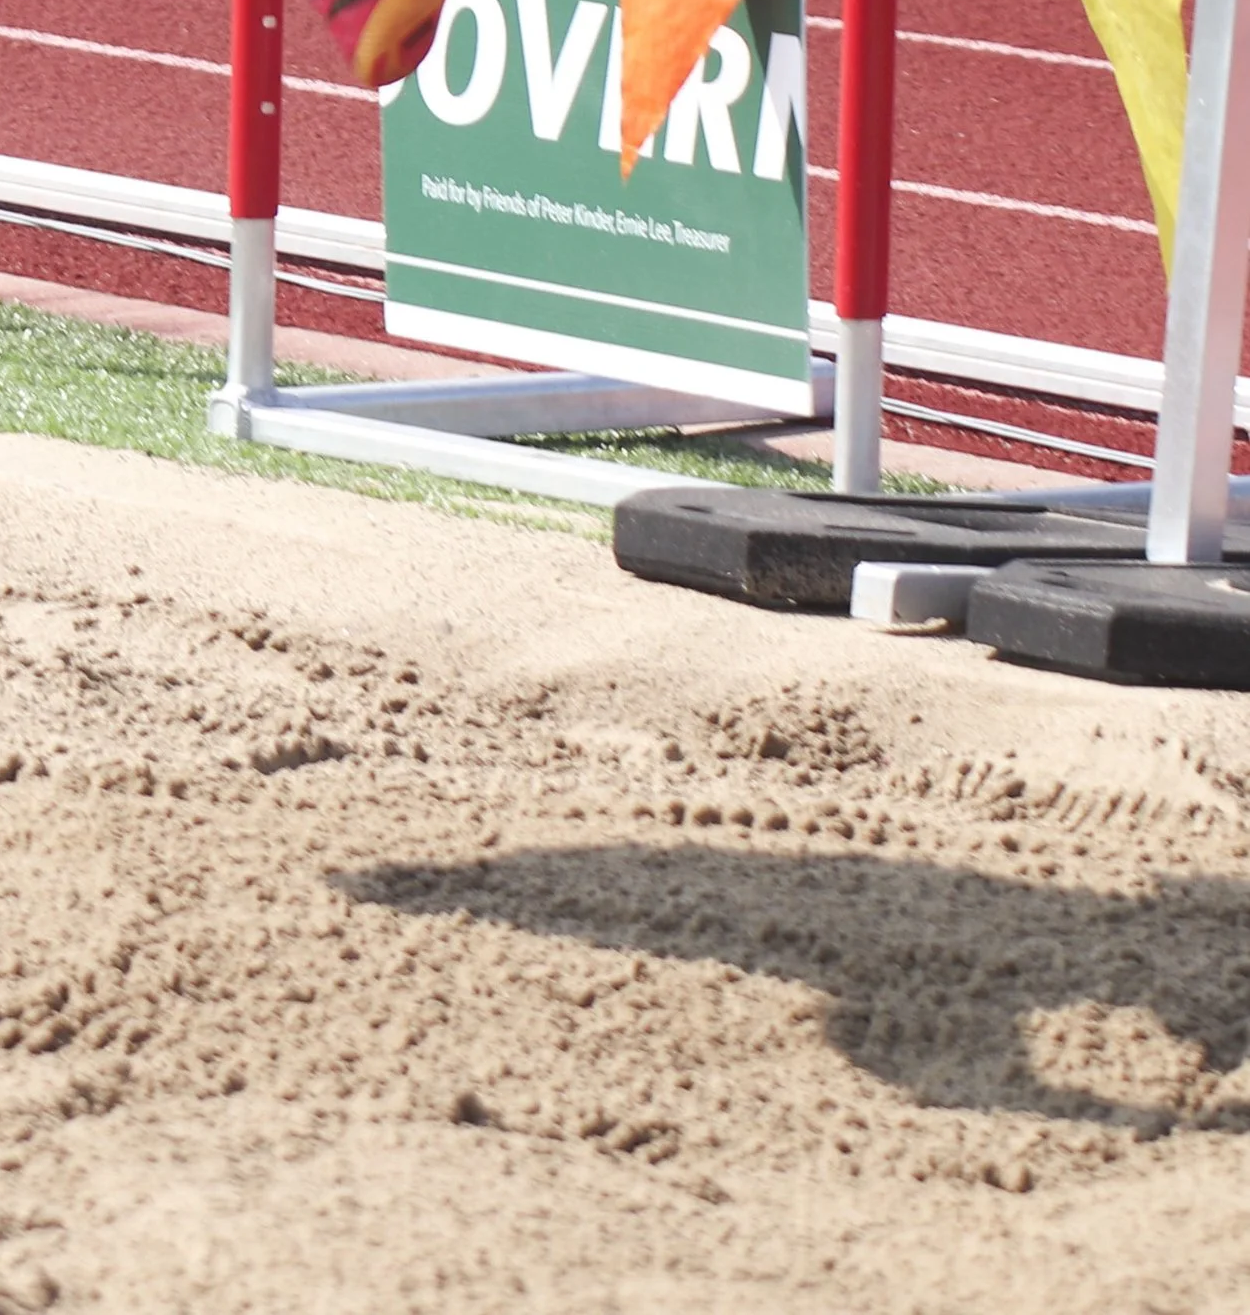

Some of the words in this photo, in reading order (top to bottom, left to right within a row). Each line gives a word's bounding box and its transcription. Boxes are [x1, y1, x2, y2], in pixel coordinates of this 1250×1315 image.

[421, 173, 449, 201] Paid
[449, 177, 465, 204] for
[465, 181, 481, 214] by
[482, 185, 527, 217] Friends
[526, 193, 541, 219] of
[541, 195, 574, 225] Peter
[615, 209, 648, 239] Ernie
[672, 219, 731, 254] Treasurer
